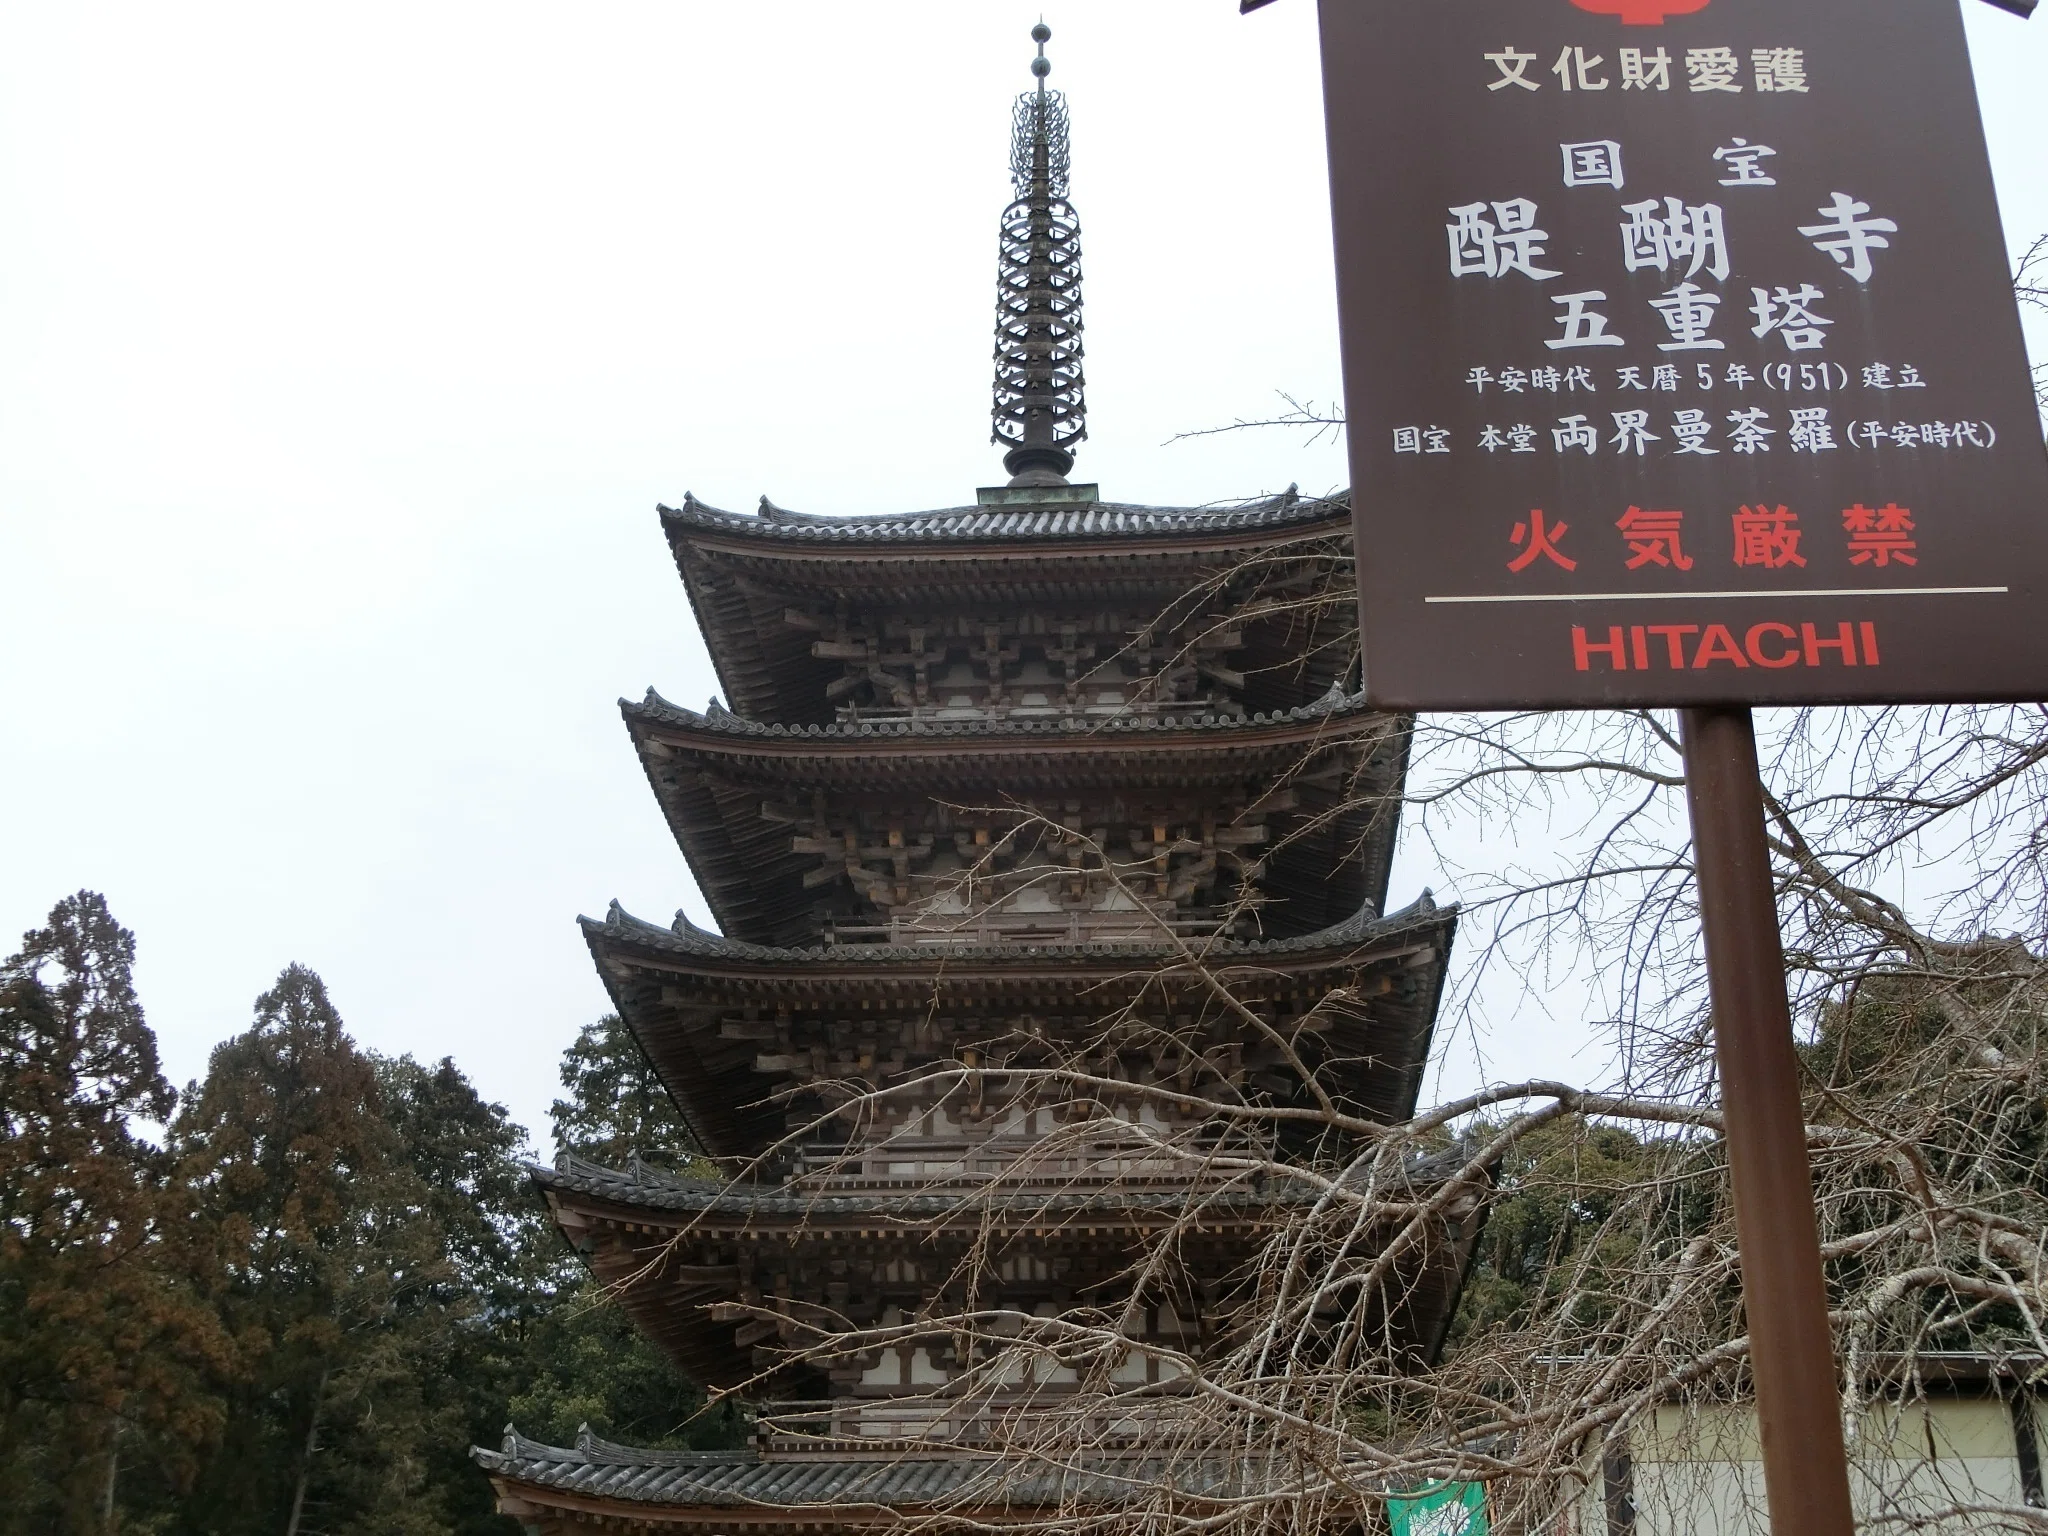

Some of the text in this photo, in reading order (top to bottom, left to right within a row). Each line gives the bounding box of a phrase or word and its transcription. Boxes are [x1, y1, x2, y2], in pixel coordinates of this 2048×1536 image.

[1483, 45, 1810, 93] 文化財愛護
[1559, 136, 1777, 190] 国宝
[1445, 191, 1898, 283] 醍醐寺
[1543, 283, 1835, 352] 五重塔
[1465, 365, 1596, 394] 平安時代
[1860, 361, 1927, 390] 建立
[1392, 424, 1451, 454] 国宝
[1508, 503, 1917, 572] 火気厳禁
[1571, 621, 1880, 671] HITACHI
